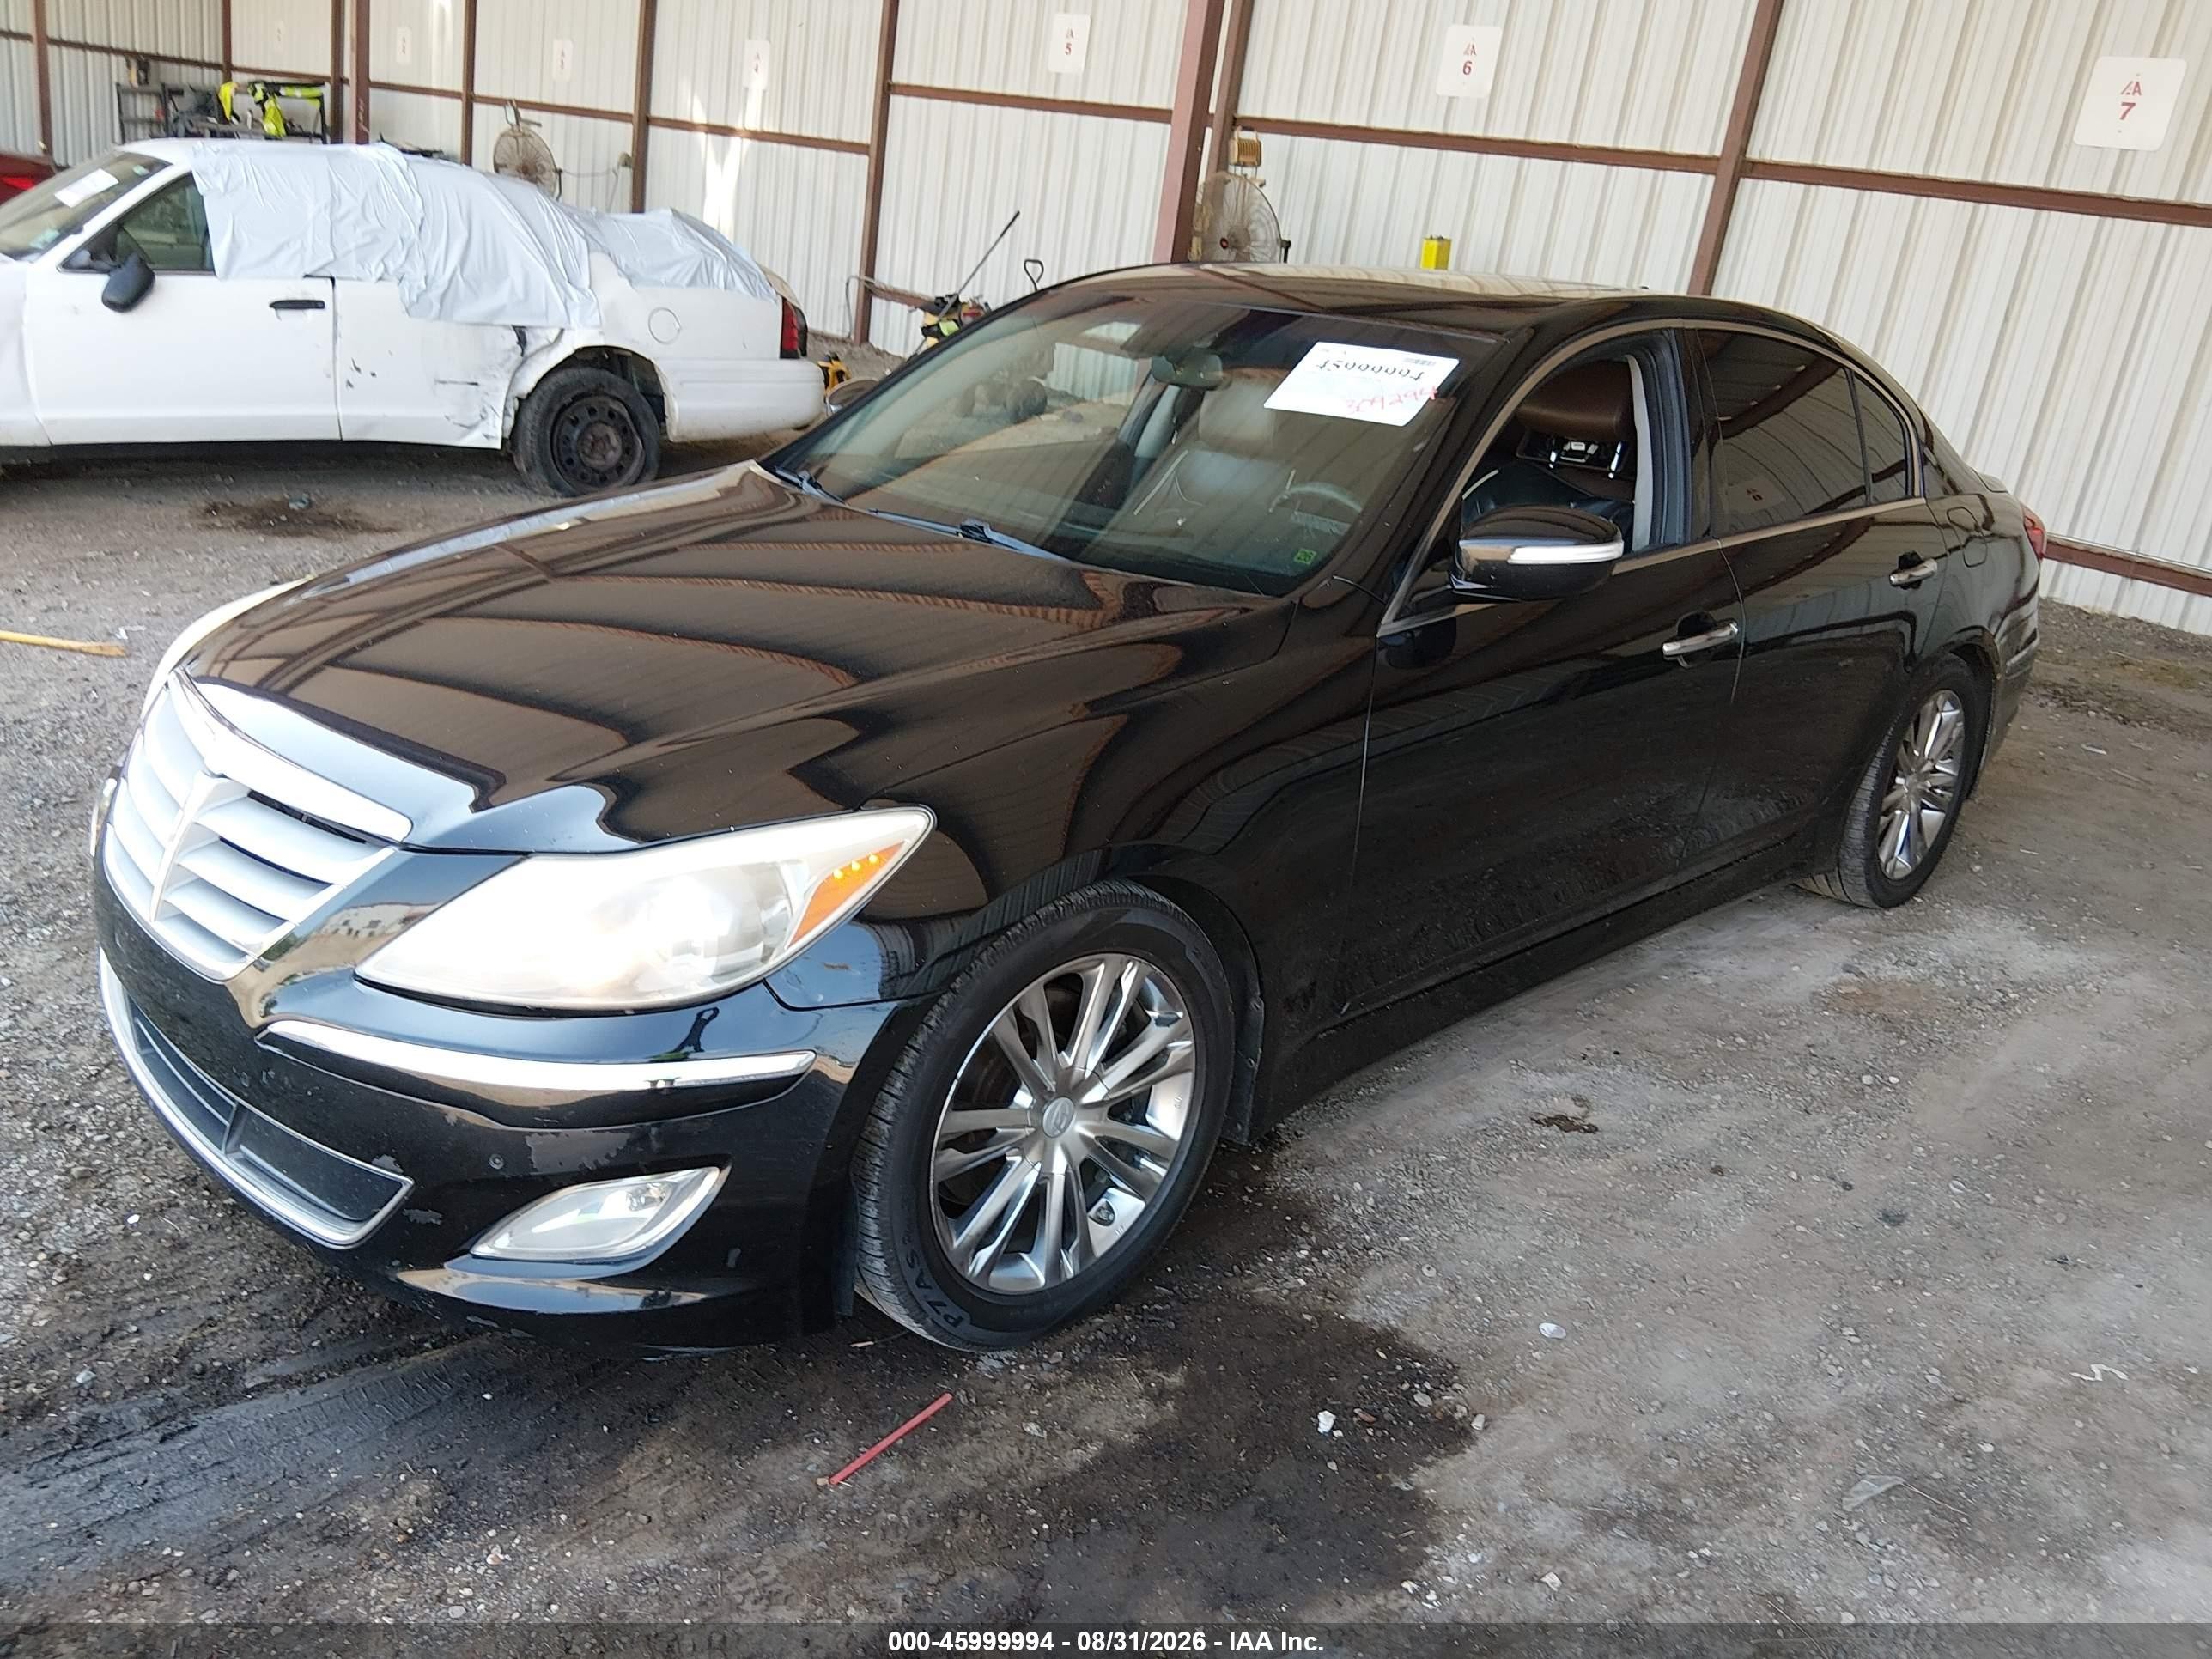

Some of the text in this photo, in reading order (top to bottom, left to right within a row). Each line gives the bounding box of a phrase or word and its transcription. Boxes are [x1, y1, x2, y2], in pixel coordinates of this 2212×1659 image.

[1065, 42, 1073, 56] 5
[1462, 60, 1473, 76] 6
[2119, 101, 2136, 121] 7
[905, 1249, 933, 1291] AS
[925, 1299, 963, 1328] P7
